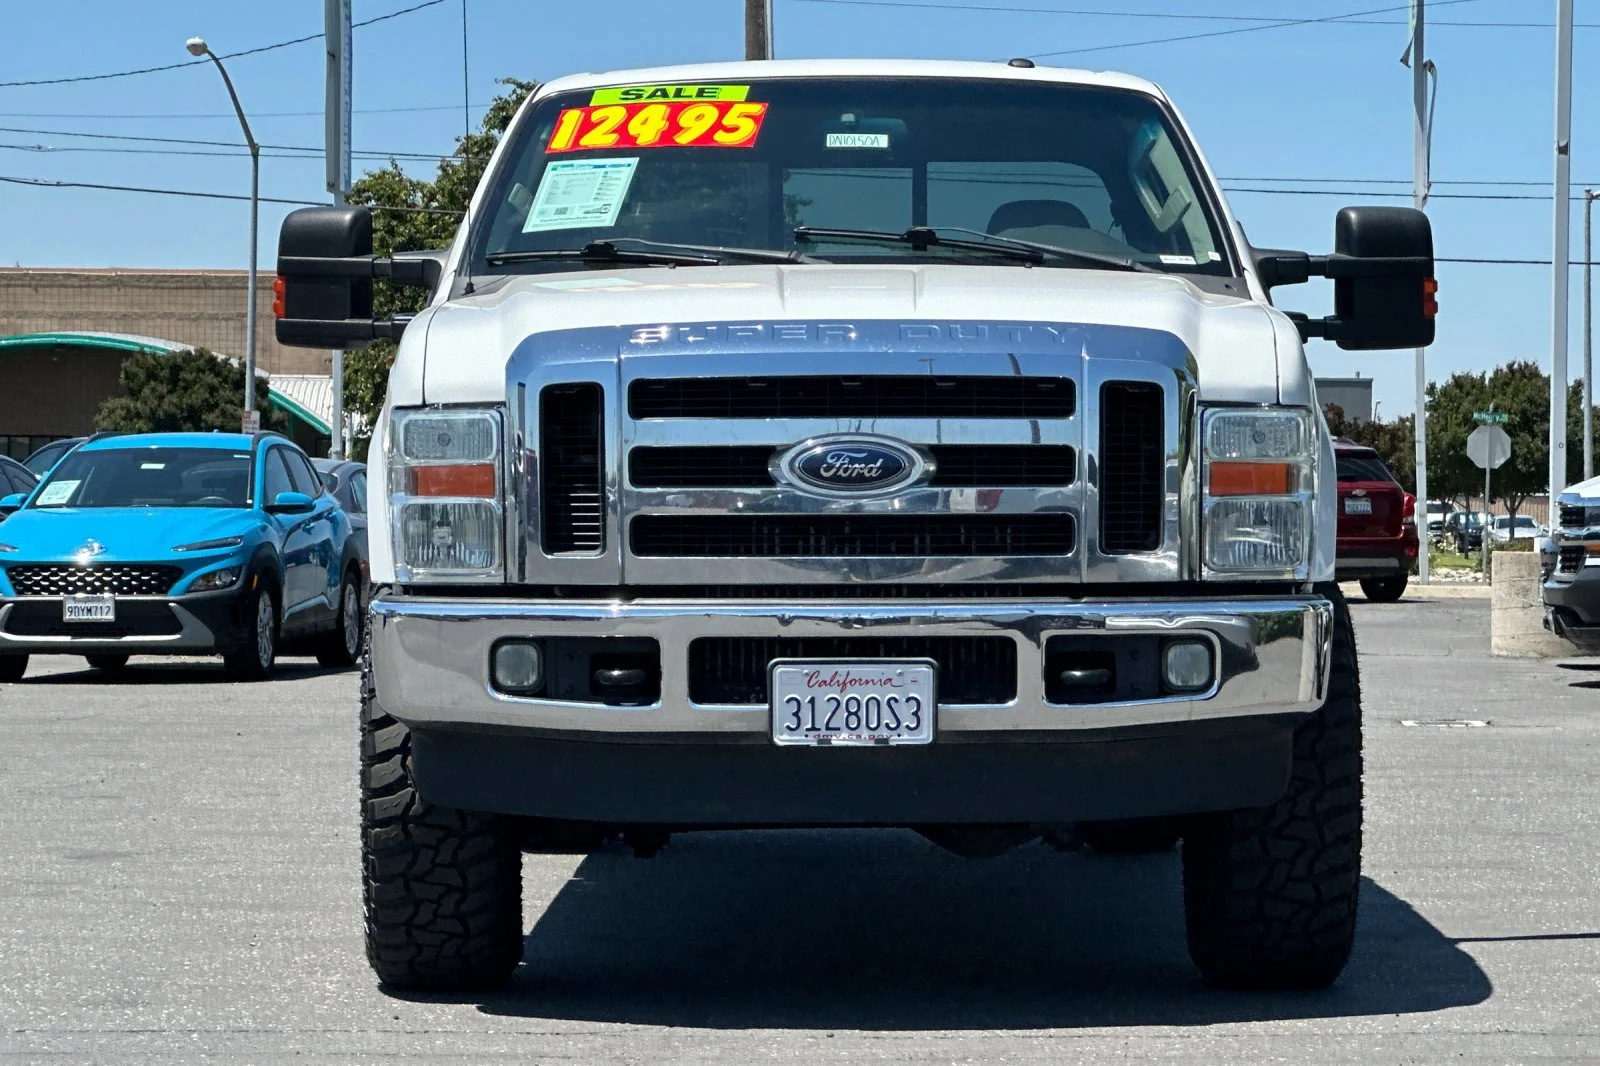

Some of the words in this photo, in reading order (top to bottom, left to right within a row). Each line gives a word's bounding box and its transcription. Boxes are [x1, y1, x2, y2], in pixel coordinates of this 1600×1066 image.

[618, 87, 722, 100] SALE
[549, 103, 764, 150] 12495
[629, 324, 857, 344] SUPER
[899, 324, 1078, 344] DUTY
[819, 451, 884, 478] Ford
[806, 670, 903, 693] California
[784, 695, 921, 732] 31280S3
